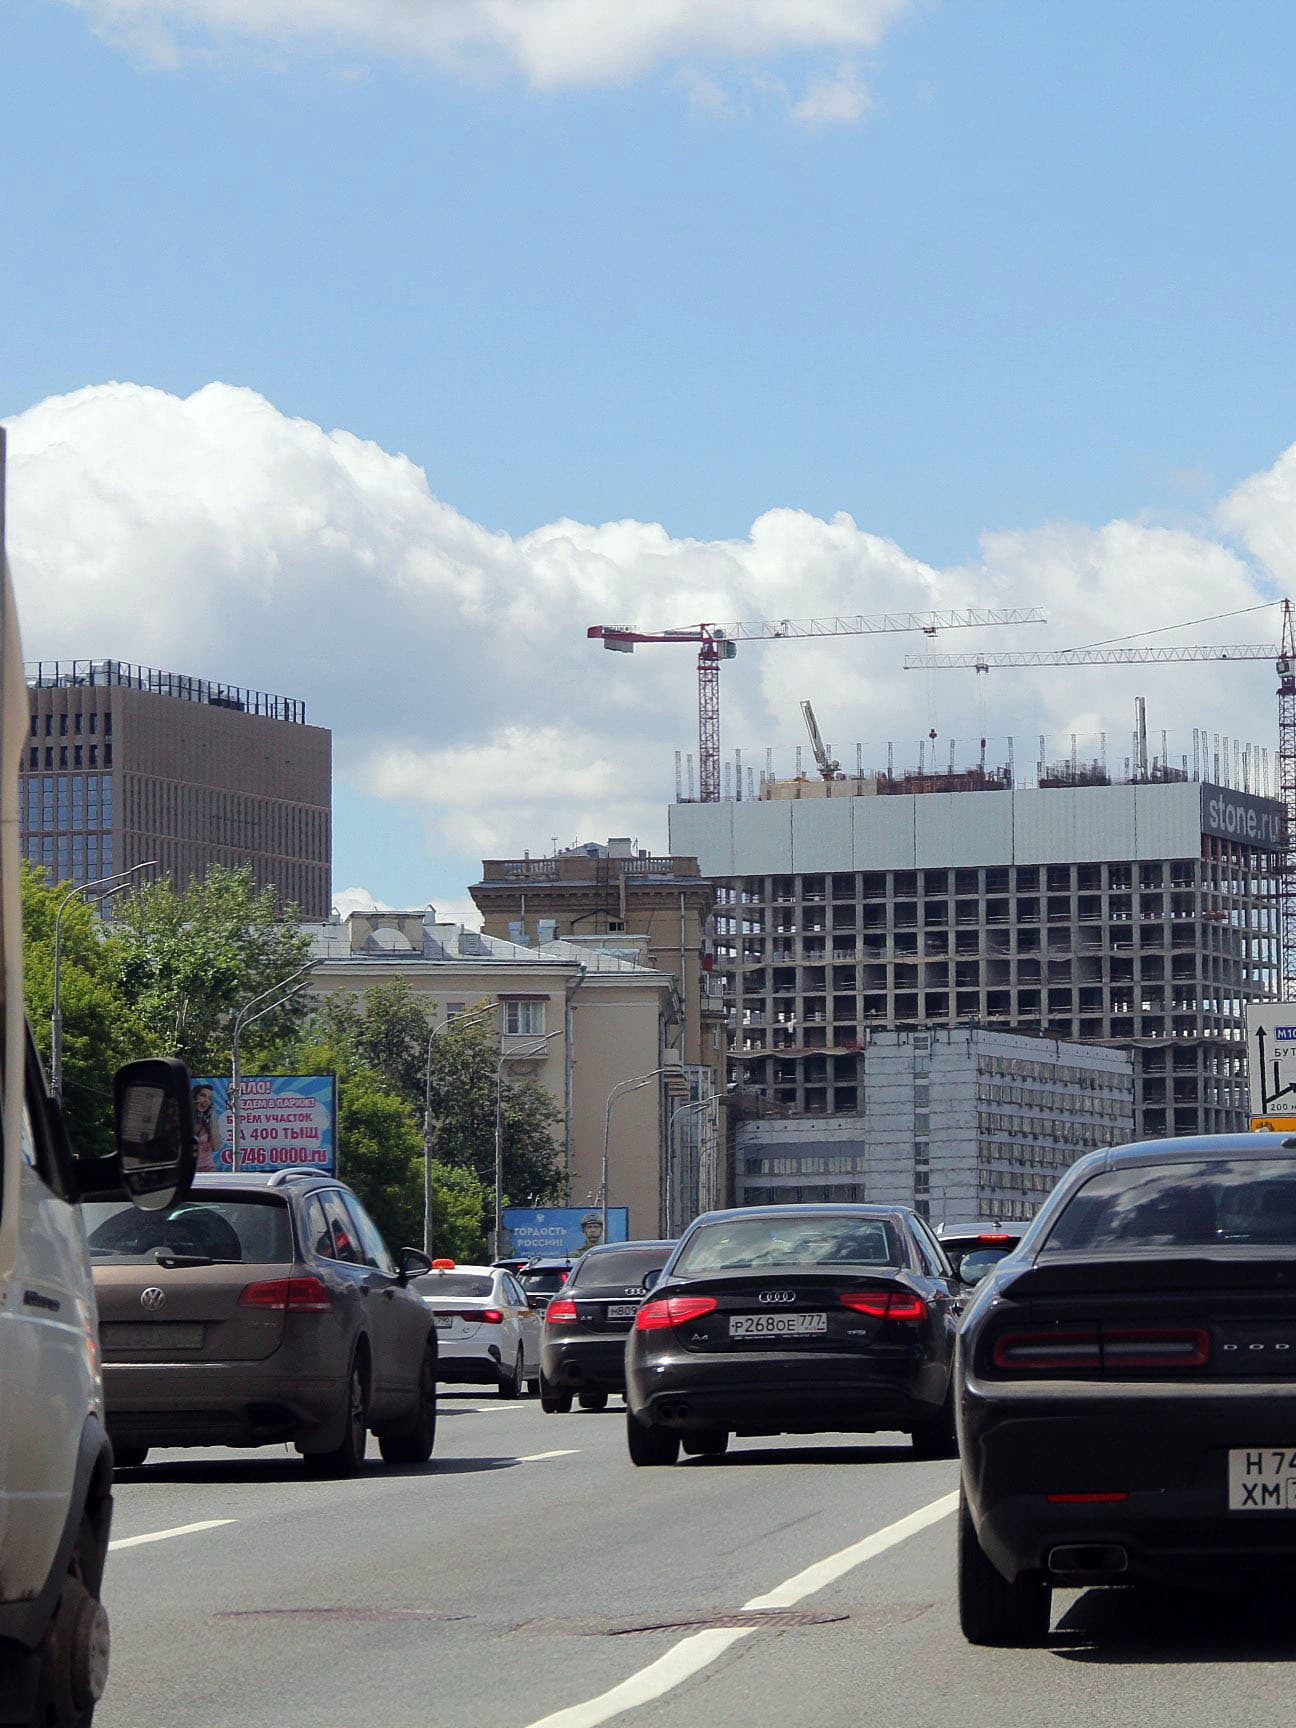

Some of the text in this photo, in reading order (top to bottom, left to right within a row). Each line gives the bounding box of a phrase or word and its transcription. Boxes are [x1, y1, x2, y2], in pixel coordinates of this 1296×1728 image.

[1210, 794, 1279, 842] stone.ru
[1271, 1103, 1288, 1112] 200
[226, 1112, 312, 1125] БРЁМ УЧАСТОК
[250, 1127, 278, 1140] 400
[514, 1227, 567, 1236] ГОРДОСТЬ
[800, 1314, 823, 1327] 777
